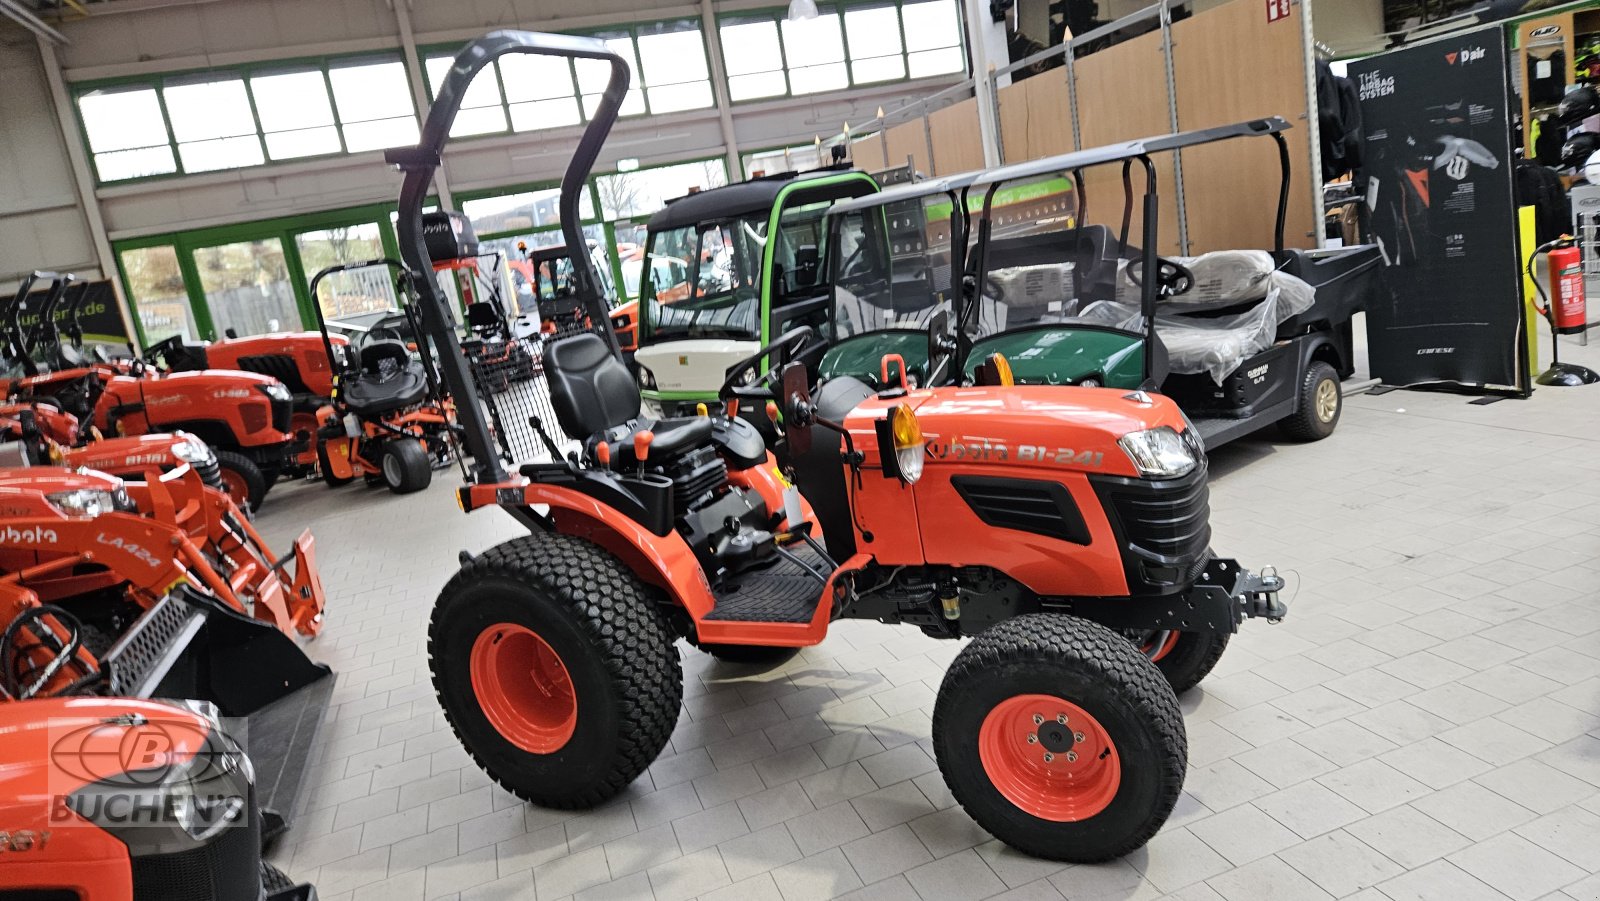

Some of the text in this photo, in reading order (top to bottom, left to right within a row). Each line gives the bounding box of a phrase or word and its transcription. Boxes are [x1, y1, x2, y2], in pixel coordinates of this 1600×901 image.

[1358, 69, 1380, 84] THE
[1360, 76, 1395, 92] AIRBAG
[1360, 85, 1395, 101] SYSTEM
[924, 437, 1009, 461] Kubota
[97, 532, 161, 567] LA424
